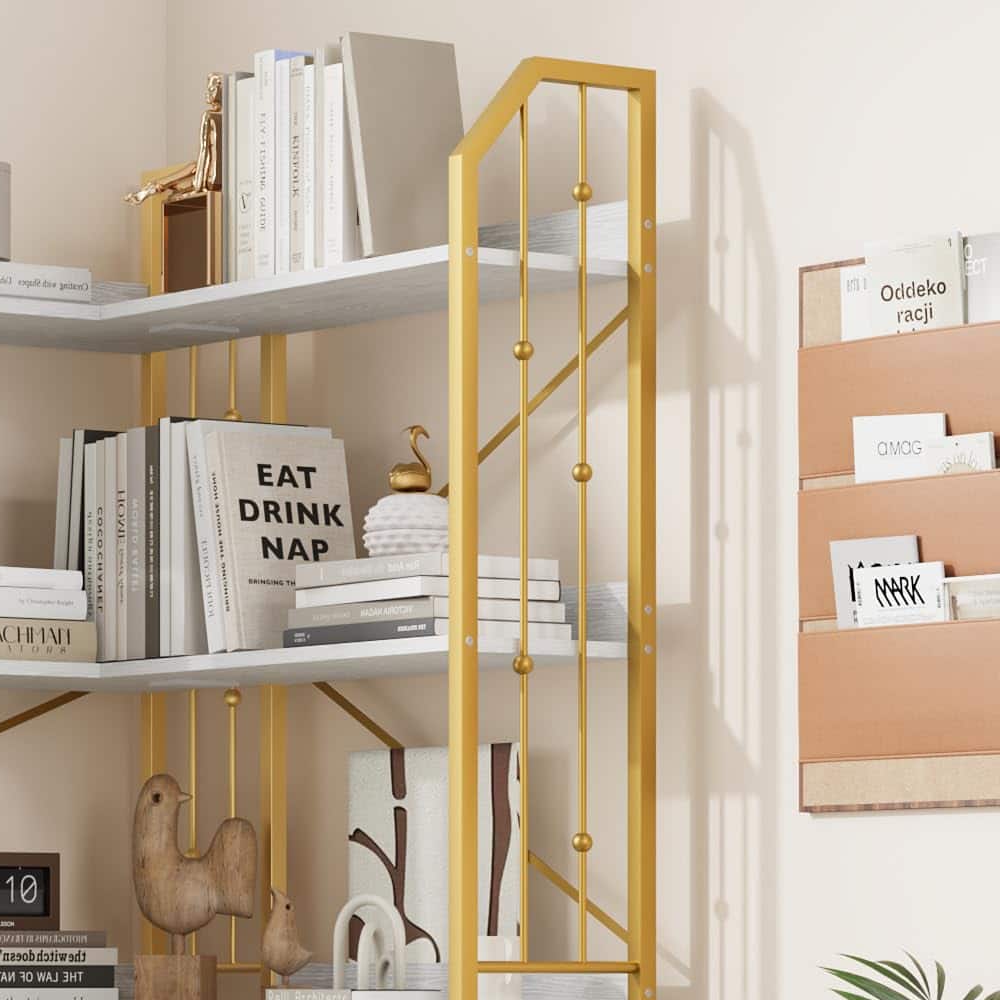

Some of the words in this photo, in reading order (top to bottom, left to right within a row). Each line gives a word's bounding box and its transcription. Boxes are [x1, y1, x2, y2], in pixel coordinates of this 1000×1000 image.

[292, 135, 301, 198] KINFOLK
[880, 279, 946, 302] Oddeko
[897, 302, 933, 325] racji
[257, 464, 316, 489] EAT
[239, 498, 344, 527] DRINK
[261, 536, 328, 562] NAP
[875, 575, 925, 607] MARK
[6, 874, 38, 904] 10
